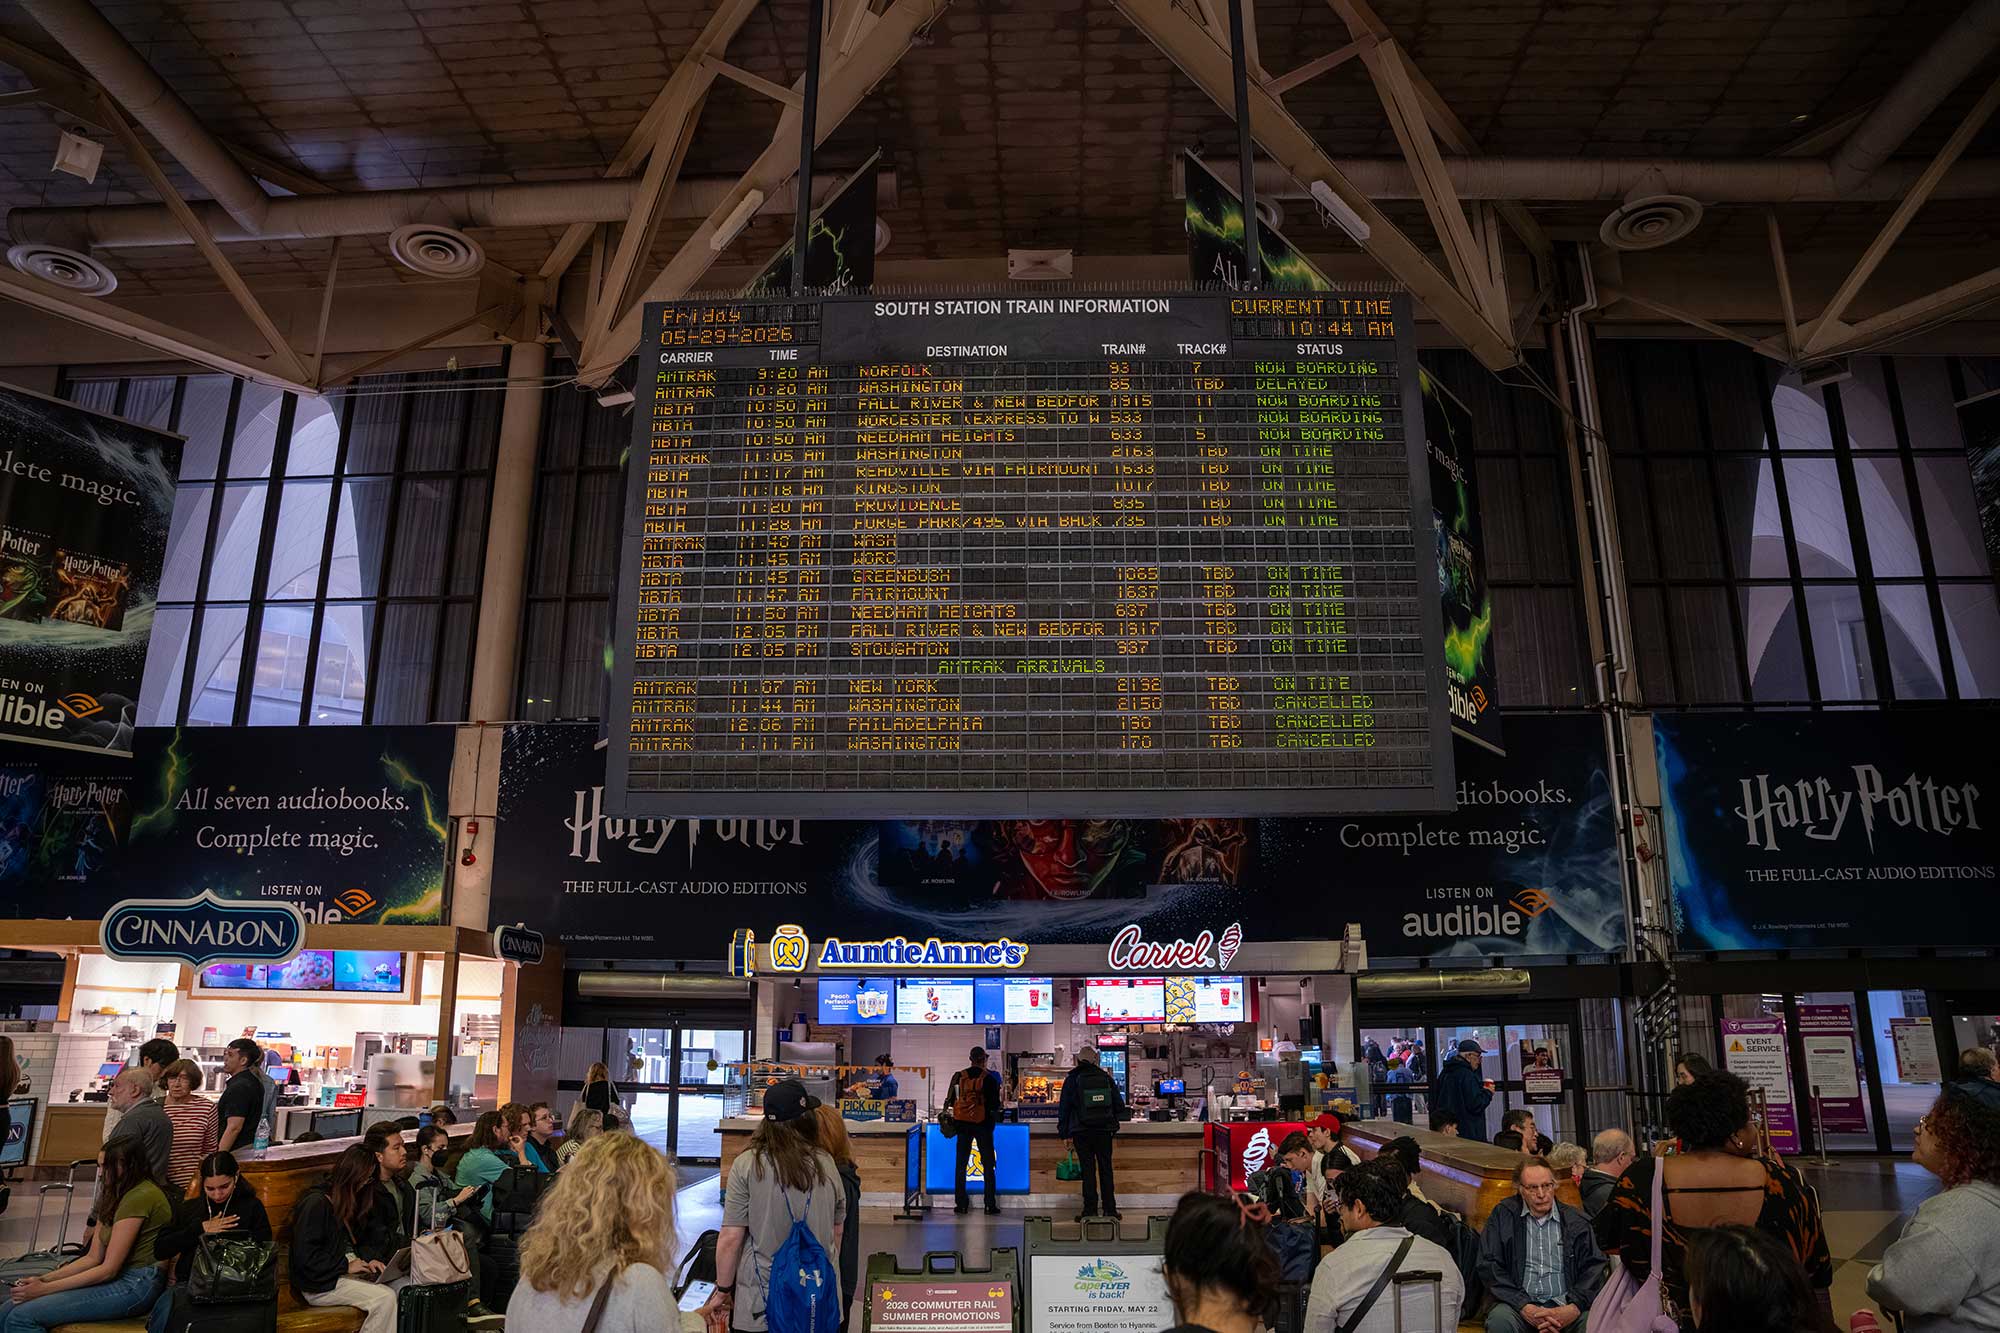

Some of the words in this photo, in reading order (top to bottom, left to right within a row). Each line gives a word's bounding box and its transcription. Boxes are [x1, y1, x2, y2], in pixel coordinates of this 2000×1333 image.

[874, 302, 930, 317] SOUTH
[933, 301, 1000, 316] STATION
[1007, 301, 1057, 314] TRAIN
[1059, 299, 1170, 314] INFORMATION
[1232, 300, 1324, 314] CURRENT
[1339, 300, 1392, 314] TIME
[664, 309, 741, 323] Friday
[662, 328, 793, 344] 05-29-2026
[1292, 322, 1352, 336] 10:44
[1368, 322, 1394, 336] AM
[660, 351, 713, 364] CARRIER
[769, 349, 798, 362] TIME
[926, 345, 1007, 358] DESTINATION
[1102, 343, 1146, 356] TRAIN#
[1177, 343, 1227, 356] TRACK#
[1296, 343, 1343, 356] STATUS
[658, 370, 716, 382] AMTRAK
[760, 368, 796, 379] 9:20
[808, 368, 828, 378] AM
[860, 366, 932, 377] NORFOLK
[1110, 362, 1128, 374] 93
[1194, 362, 1200, 372] 7
[1256, 364, 1286, 374] NOW
[1296, 363, 1376, 374] BOARDING
[656, 387, 715, 398] AMTRAK
[750, 384, 796, 396] 10:20
[808, 384, 827, 394] AM
[860, 381, 962, 392] WASHINGTON
[1110, 378, 1129, 390] 85
[1196, 378, 1224, 390] TBD
[1256, 378, 1328, 390] DELAYED
[654, 404, 694, 415] MBTA
[748, 400, 795, 412] 10:50
[806, 400, 826, 410] AM
[858, 398, 898, 410] FALL
[910, 398, 962, 409] RIVER
[995, 396, 1025, 408] NEW
[1036, 396, 1098, 408] BEDFOR
[1114, 396, 1152, 407] 1915
[1196, 396, 1211, 406] 11
[1258, 396, 1288, 406] NOW
[1298, 396, 1380, 406] BOARDING
[653, 420, 692, 432] MBTA
[747, 416, 794, 428] 10:50
[806, 418, 826, 428] AM
[858, 414, 951, 426] WORCESTER
[961, 412, 1046, 424] (EXPRESS
[1060, 413, 1078, 424] TO
[1090, 414, 1100, 423] W
[1112, 412, 1141, 423] 533
[1198, 412, 1204, 424] 1
[1258, 412, 1289, 423] NOW
[1300, 412, 1382, 423] BOARDING
[652, 435, 691, 448] MBTA
[746, 434, 794, 445] 10:50
[806, 432, 826, 444] AM
[858, 432, 930, 442] NEEDHAM
[942, 430, 1014, 442] HEIGHTS
[1112, 430, 1142, 440] 633
[1196, 430, 1206, 440] 5
[1260, 429, 1290, 439] NOW
[1301, 429, 1382, 440] BOARDING
[59, 472, 141, 506] magic.
[64, 555, 92, 574] Harry
[92, 559, 121, 579] Potter
[854, 570, 950, 582] GREENBUSH
[852, 588, 949, 600] FAIRMOUNT
[852, 642, 948, 655] STOUGHTON
[939, 661, 1004, 672] AMTRAK
[1017, 660, 1104, 672] ARRIVALS
[0, 678, 19, 690] EN
[24, 682, 44, 694] ON
[631, 718, 694, 732] AMTRAK
[794, 718, 814, 730] PM
[848, 717, 982, 730] PHILADELPHIA
[1122, 716, 1151, 729] 190
[1210, 716, 1240, 728] TBD
[1276, 715, 1374, 728] CANCELLED
[48, 783, 88, 808] Harry
[86, 781, 123, 808] Potter
[175, 787, 209, 810] All
[214, 796, 271, 810] seven
[277, 786, 410, 811] audiobooks.
[1456, 779, 1572, 806] diobooks.
[1734, 774, 1852, 851] Harry
[1851, 764, 1982, 856] Potter
[196, 824, 302, 856] Complete
[308, 826, 379, 856] magic.
[1340, 822, 1459, 856] Complete
[1468, 822, 1546, 854] magic.
[1746, 870, 1780, 882] THE
[1782, 868, 1862, 881] FULL-CAST
[1866, 866, 1914, 880] AUDIO
[1920, 865, 1996, 879] EDITIONS
[261, 885, 301, 896] LISTEN
[305, 886, 322, 896] ON
[563, 881, 595, 894] THE
[598, 881, 678, 894] FULL-CAST
[680, 882, 730, 894] AUDIO
[732, 882, 808, 895] EDITIONS
[1426, 888, 1470, 898] LISTEN
[1476, 888, 1494, 898] ON
[1402, 904, 1520, 936] audible
[1111, 926, 1211, 968] Carvel
[844, 1100, 865, 1112] PICK
[1088, 1291, 1096, 1299] is
[1099, 1291, 1125, 1299] back!
[886, 1301, 908, 1310] 2026
[911, 1301, 971, 1310] COMMUTER
[974, 1300, 997, 1309] RAIL
[882, 1312, 928, 1321] SUMMER
[932, 1312, 1000, 1320] PROMOTIONS
